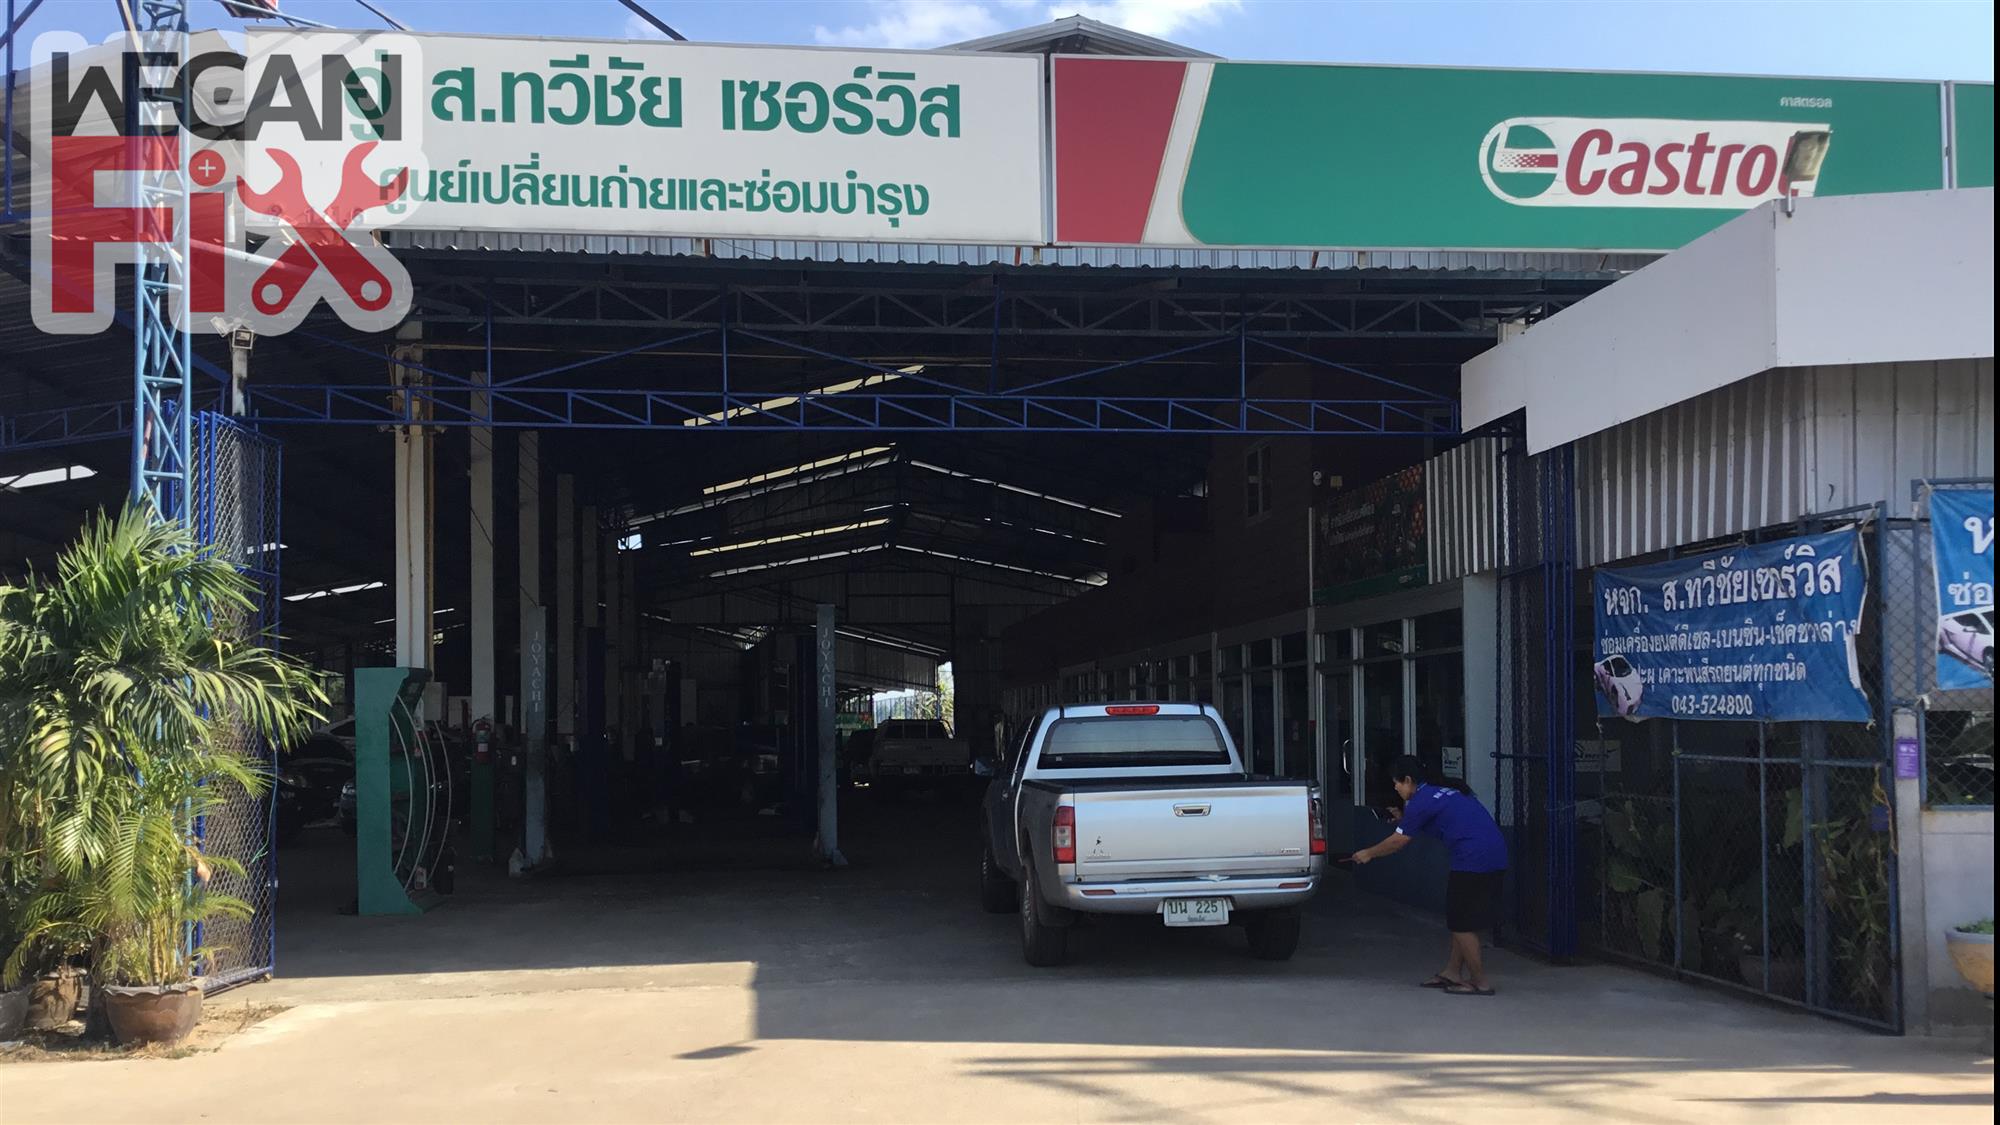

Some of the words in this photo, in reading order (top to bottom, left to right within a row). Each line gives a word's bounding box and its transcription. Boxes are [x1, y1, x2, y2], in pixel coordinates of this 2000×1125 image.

[431, 54, 683, 128] ส.ทวีชัย
[721, 65, 961, 138] เซอร์วิส
[379, 152, 930, 228] ศูนย์เปลี่ยนถ่ายและซ่อมบำรุง
[1604, 586, 1649, 616] หจก.
[531, 631, 542, 713] JOYACHI
[821, 627, 832, 708] JOYACHI
[1671, 695, 1754, 716] 043-524800
[1196, 901, 1218, 914] 225
